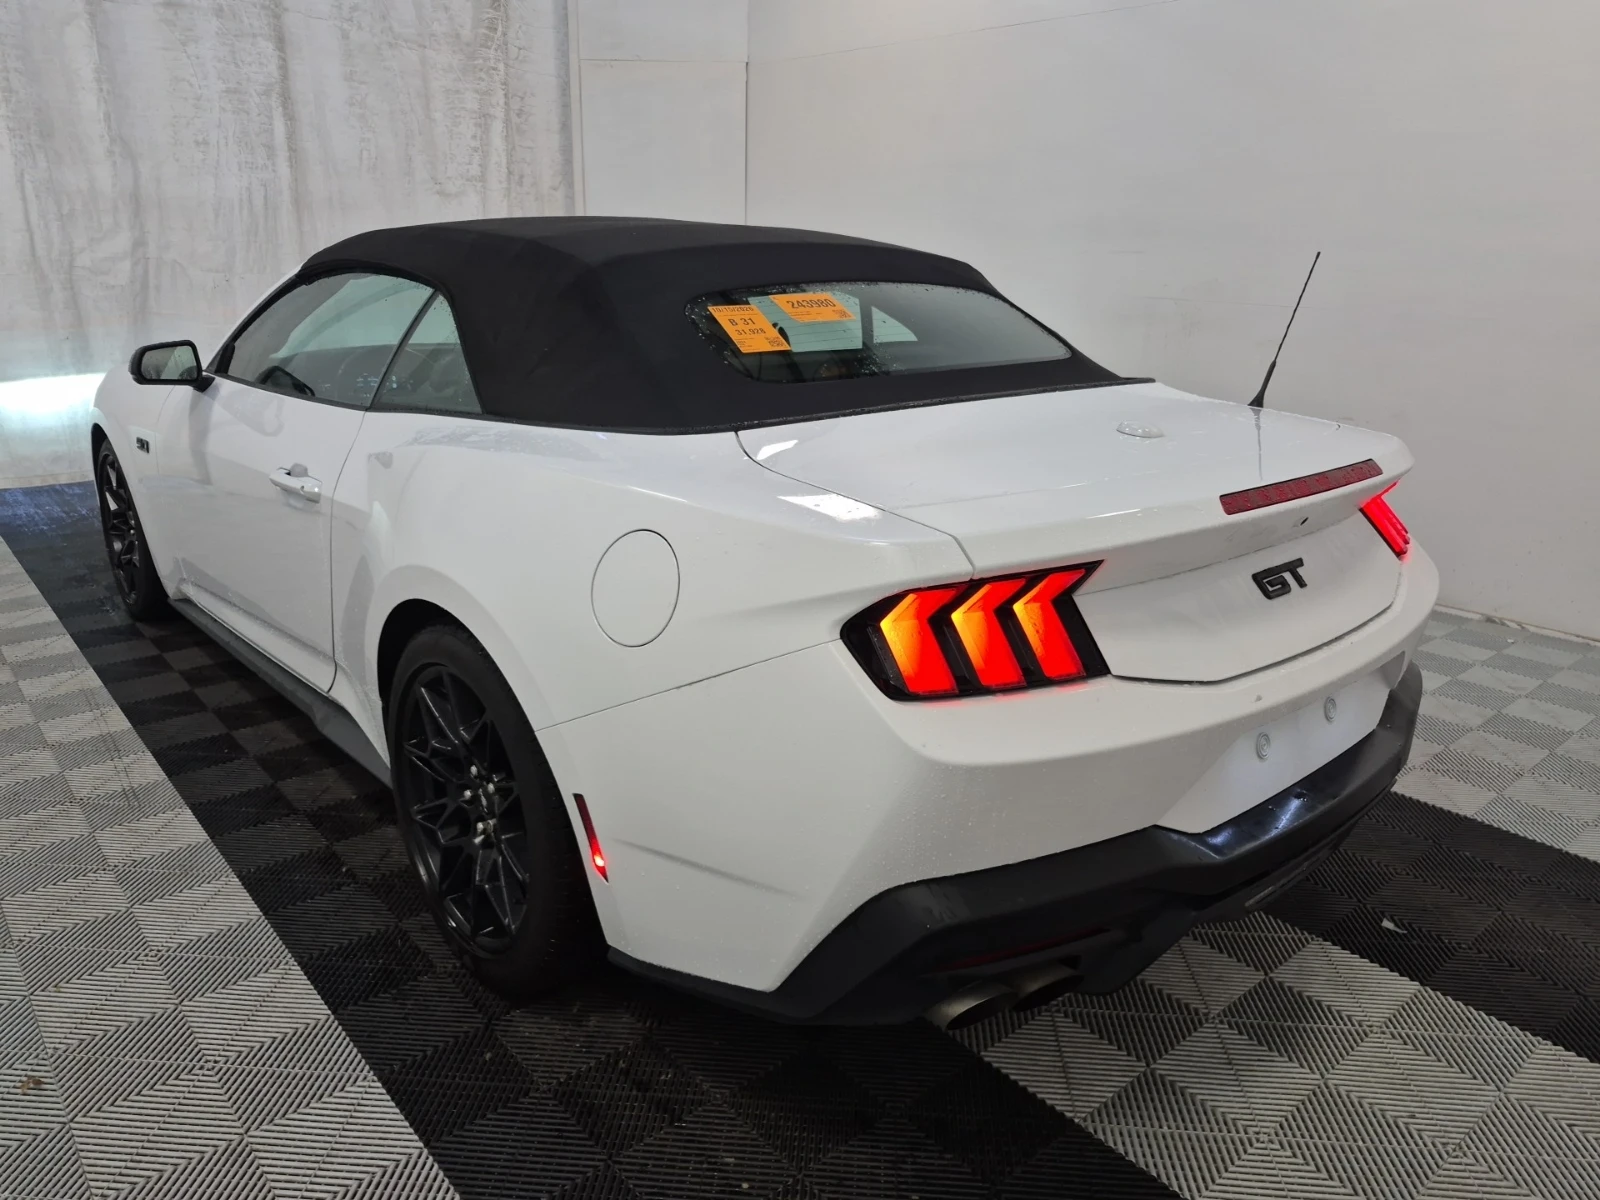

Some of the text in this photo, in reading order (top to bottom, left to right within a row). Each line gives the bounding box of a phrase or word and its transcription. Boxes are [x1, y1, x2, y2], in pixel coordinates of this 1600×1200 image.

[786, 298, 837, 309] 243980
[727, 317, 756, 326] B 31
[1252, 556, 1308, 600] GT
